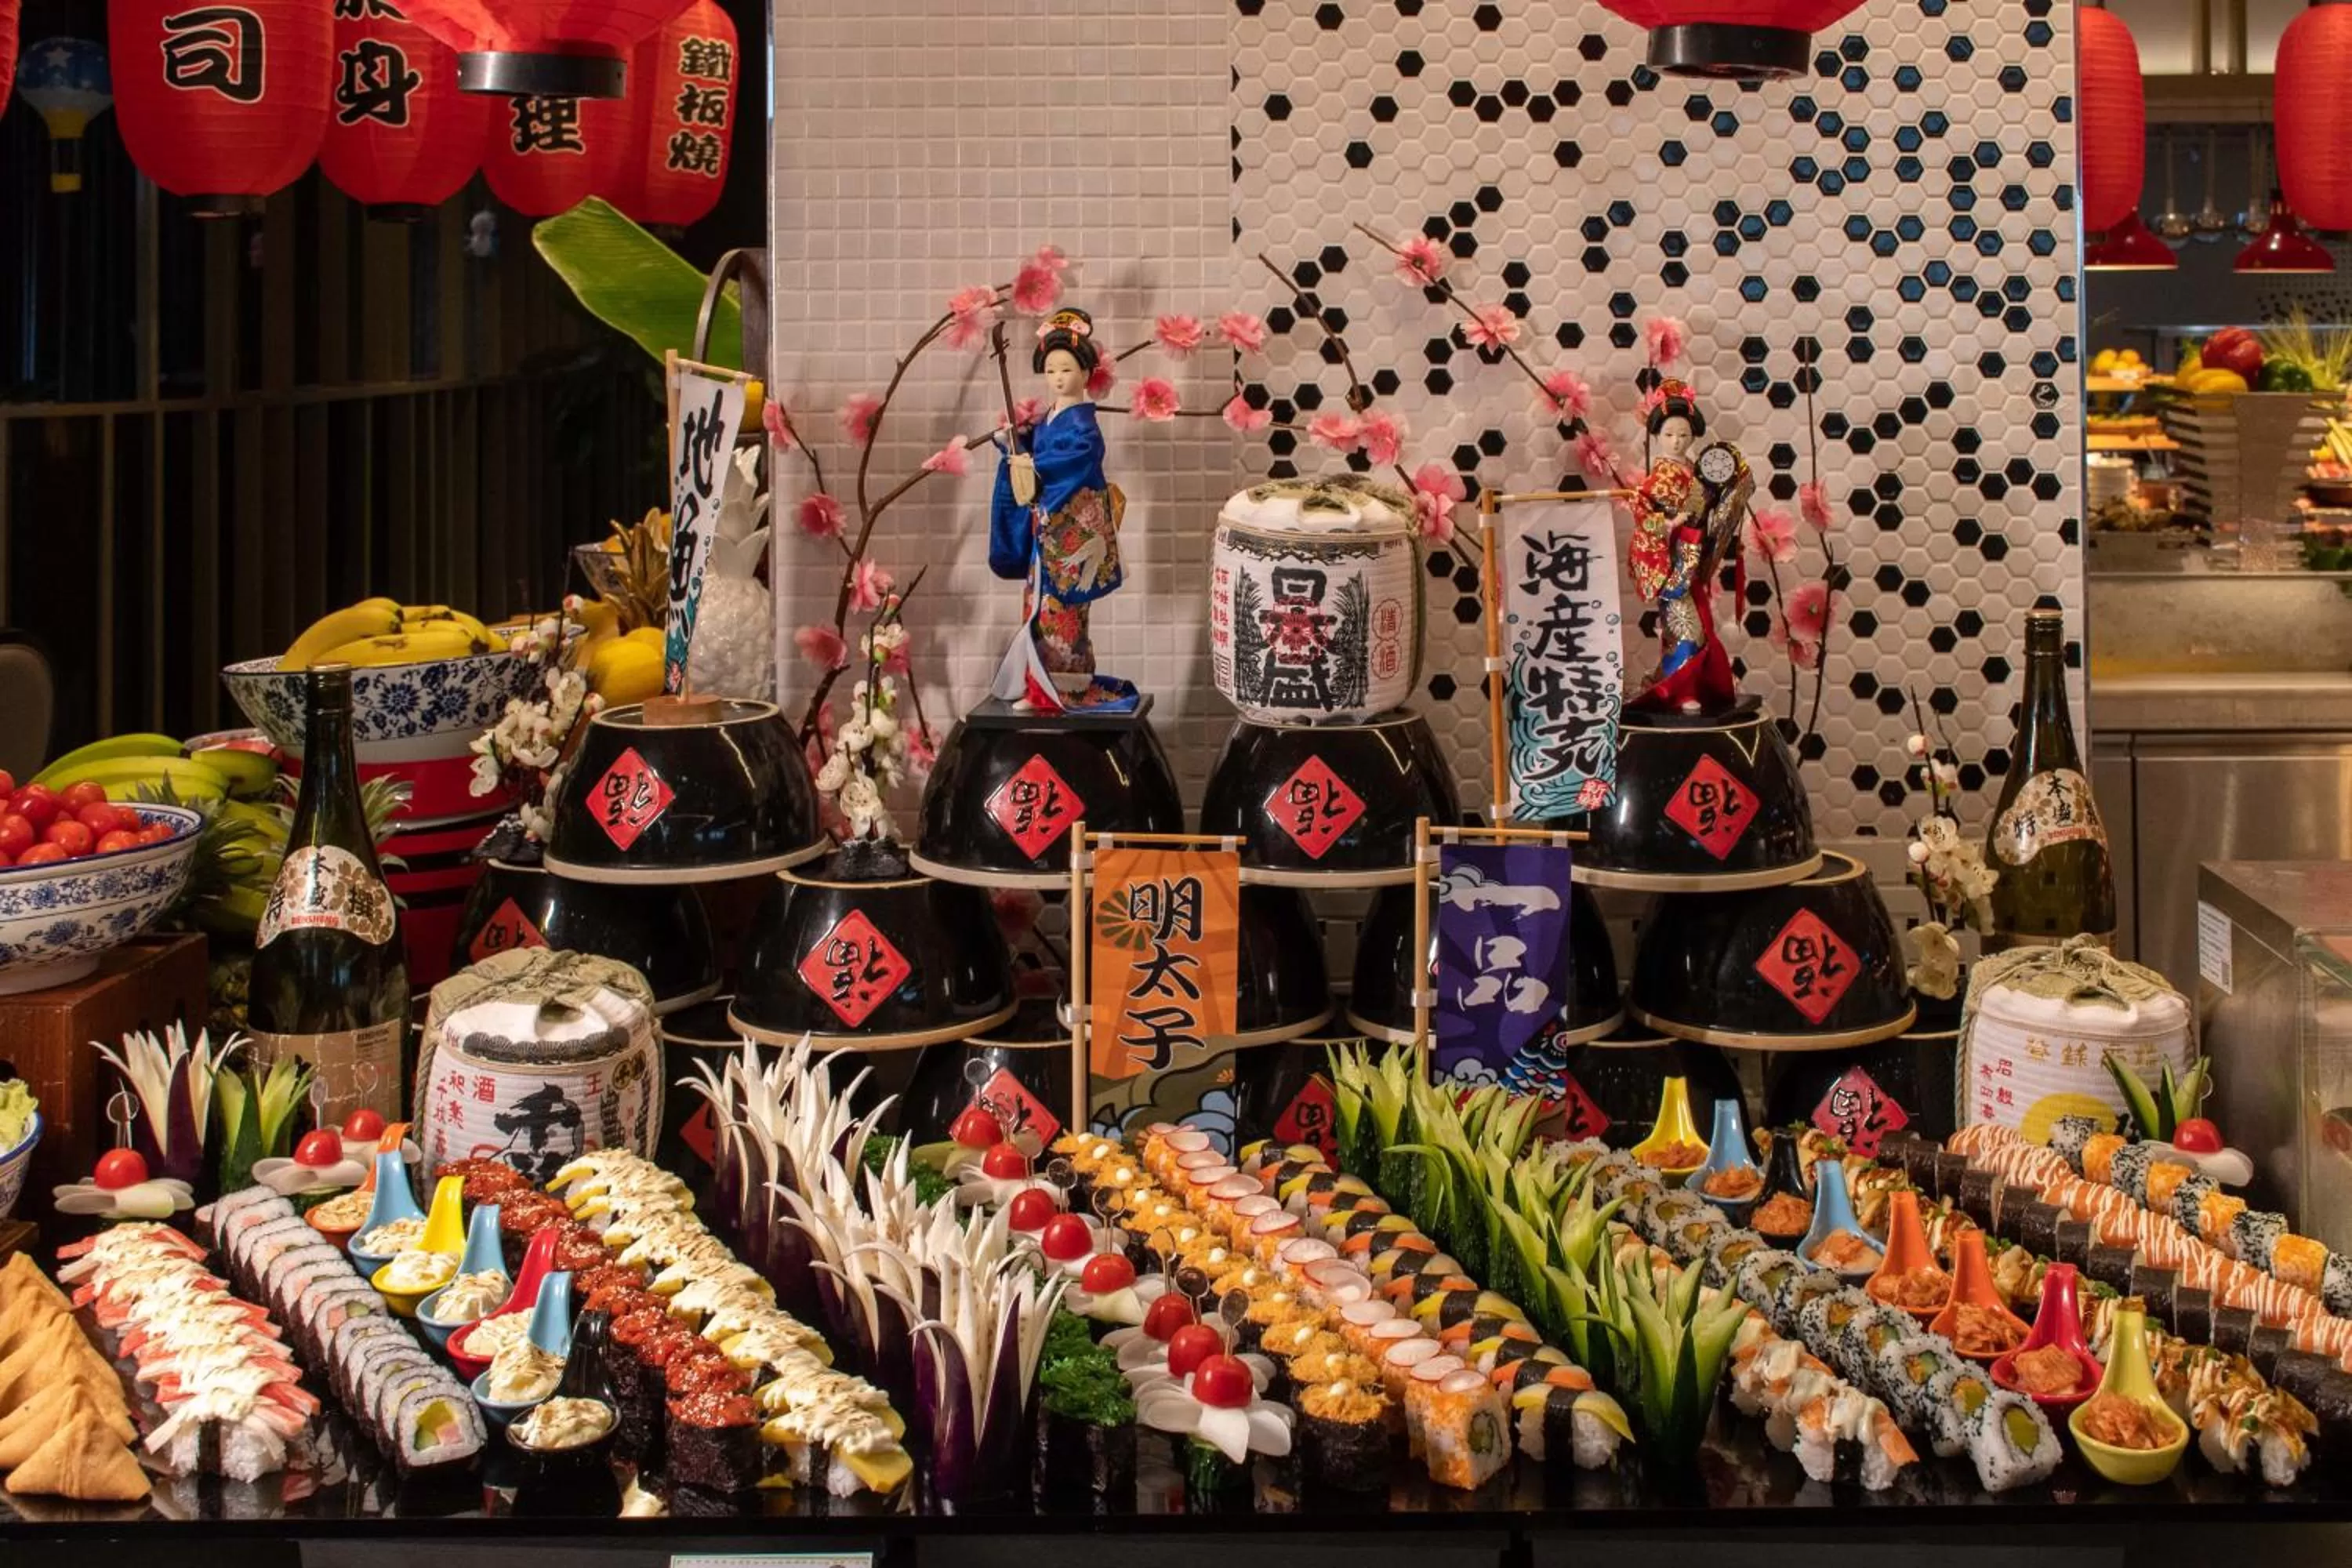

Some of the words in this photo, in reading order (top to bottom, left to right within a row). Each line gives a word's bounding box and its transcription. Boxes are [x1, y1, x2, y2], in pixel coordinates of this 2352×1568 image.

[162, 6, 265, 103] 司
[1117, 876, 1206, 1071] 明太子
[1441, 884, 1563, 1015] 一品
